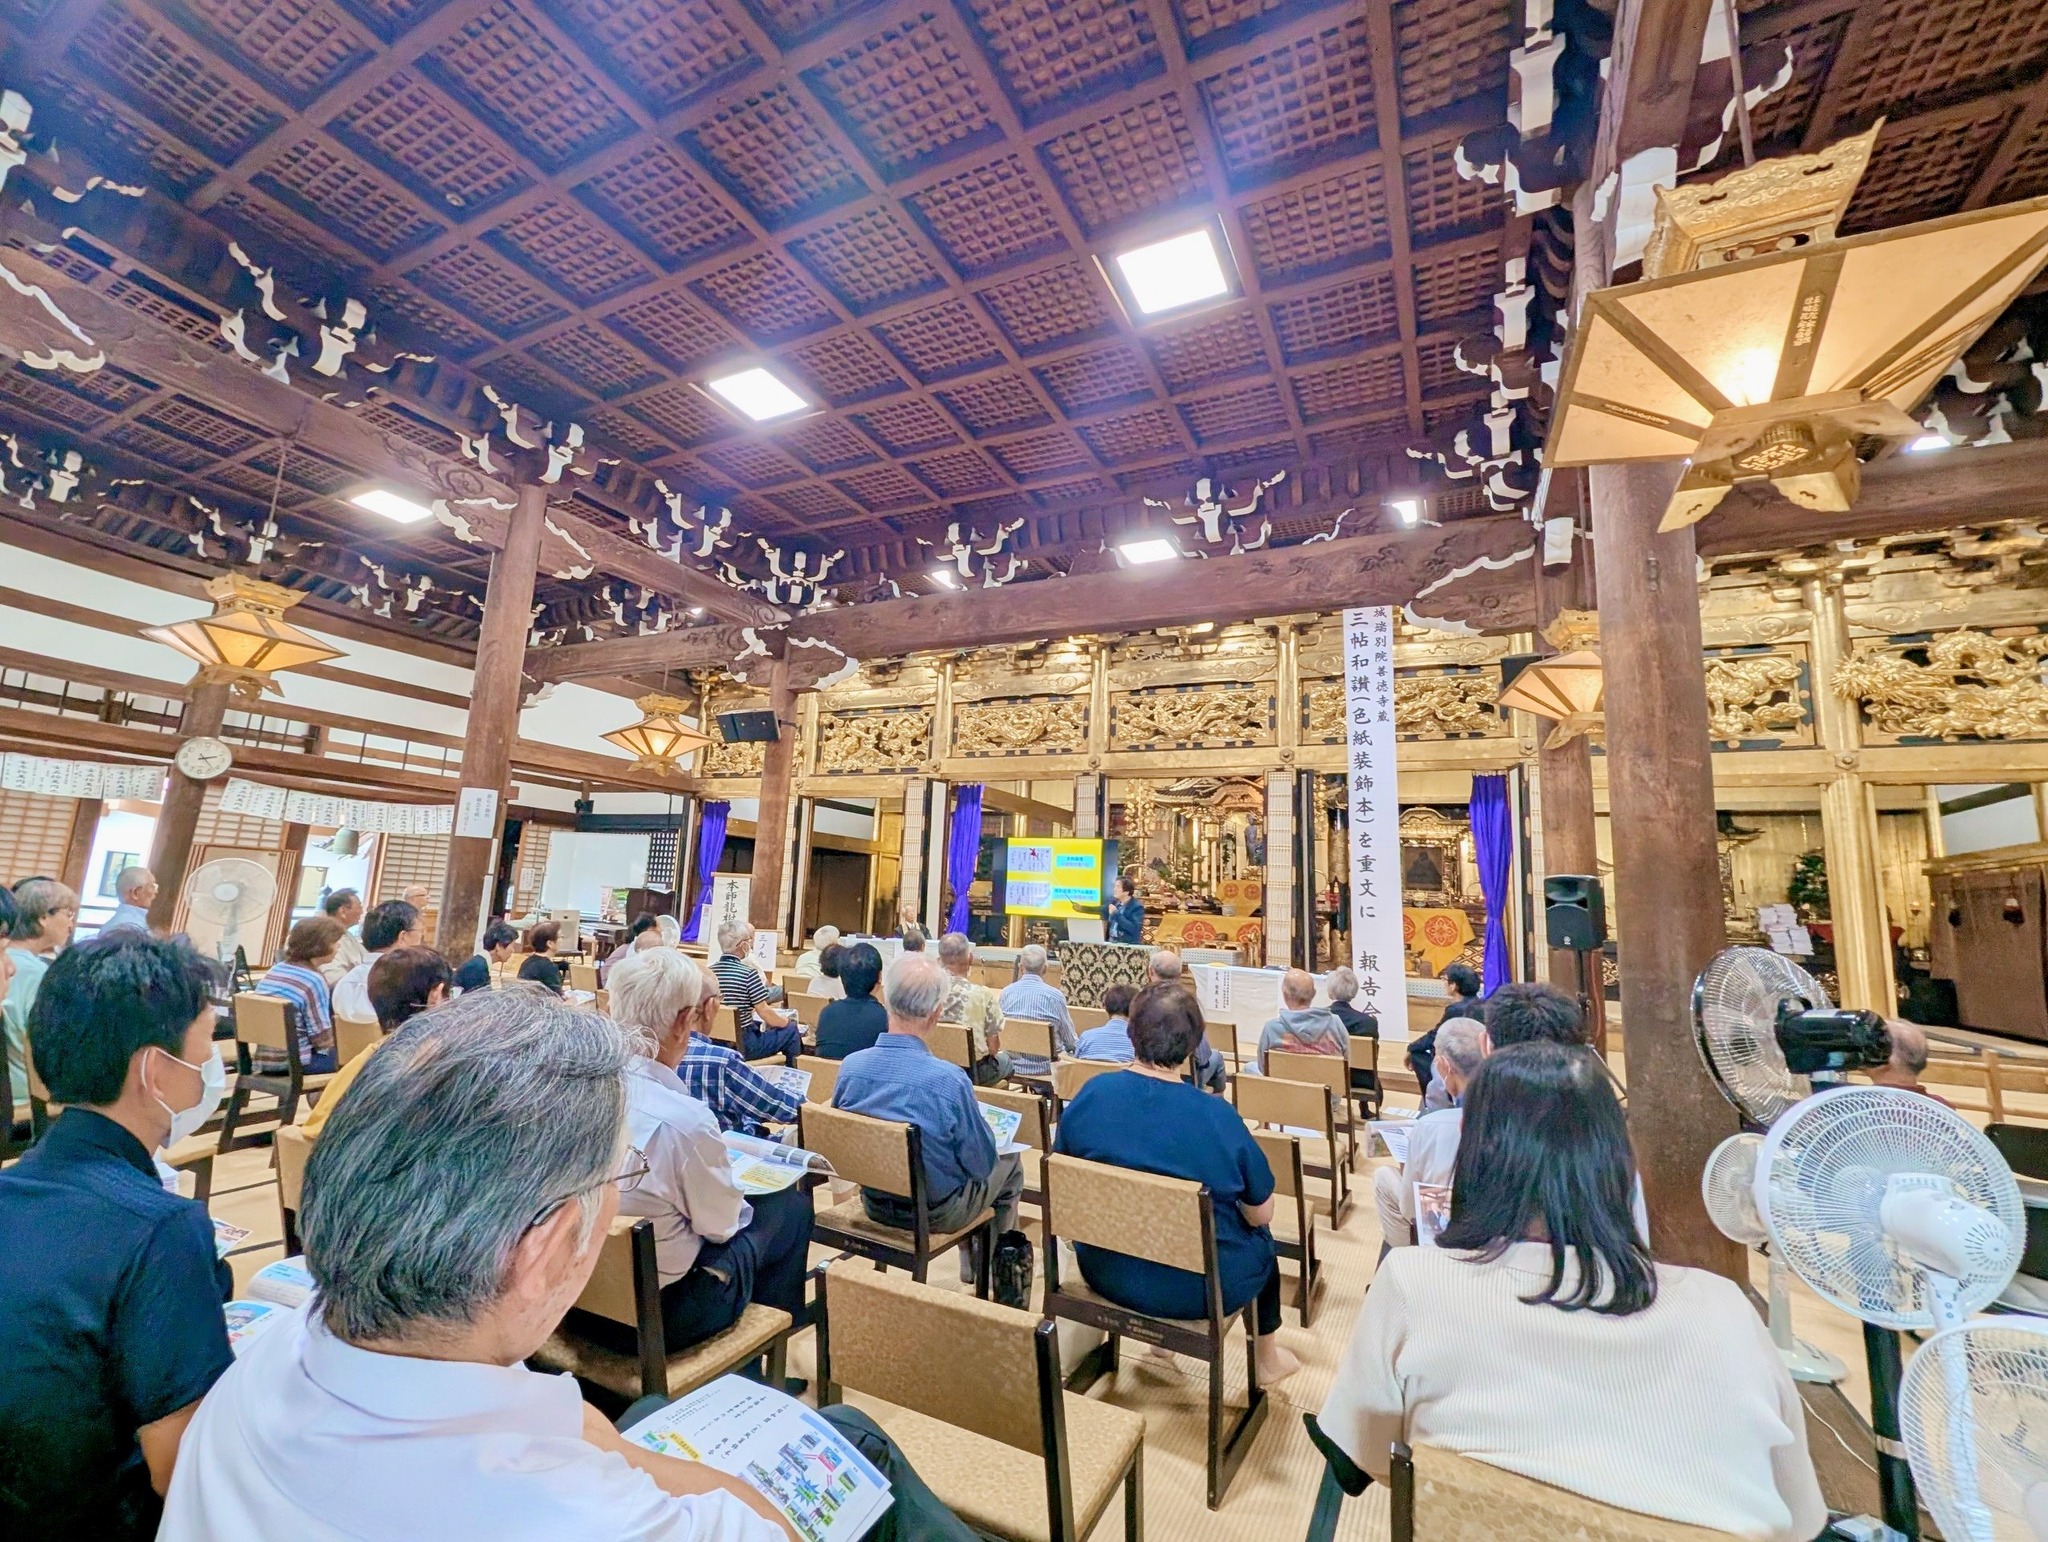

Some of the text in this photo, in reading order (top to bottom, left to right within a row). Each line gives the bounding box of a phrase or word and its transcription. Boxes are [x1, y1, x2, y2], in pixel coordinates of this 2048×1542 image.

[1373, 607, 1390, 723] 城端別院善徳寺蔵
